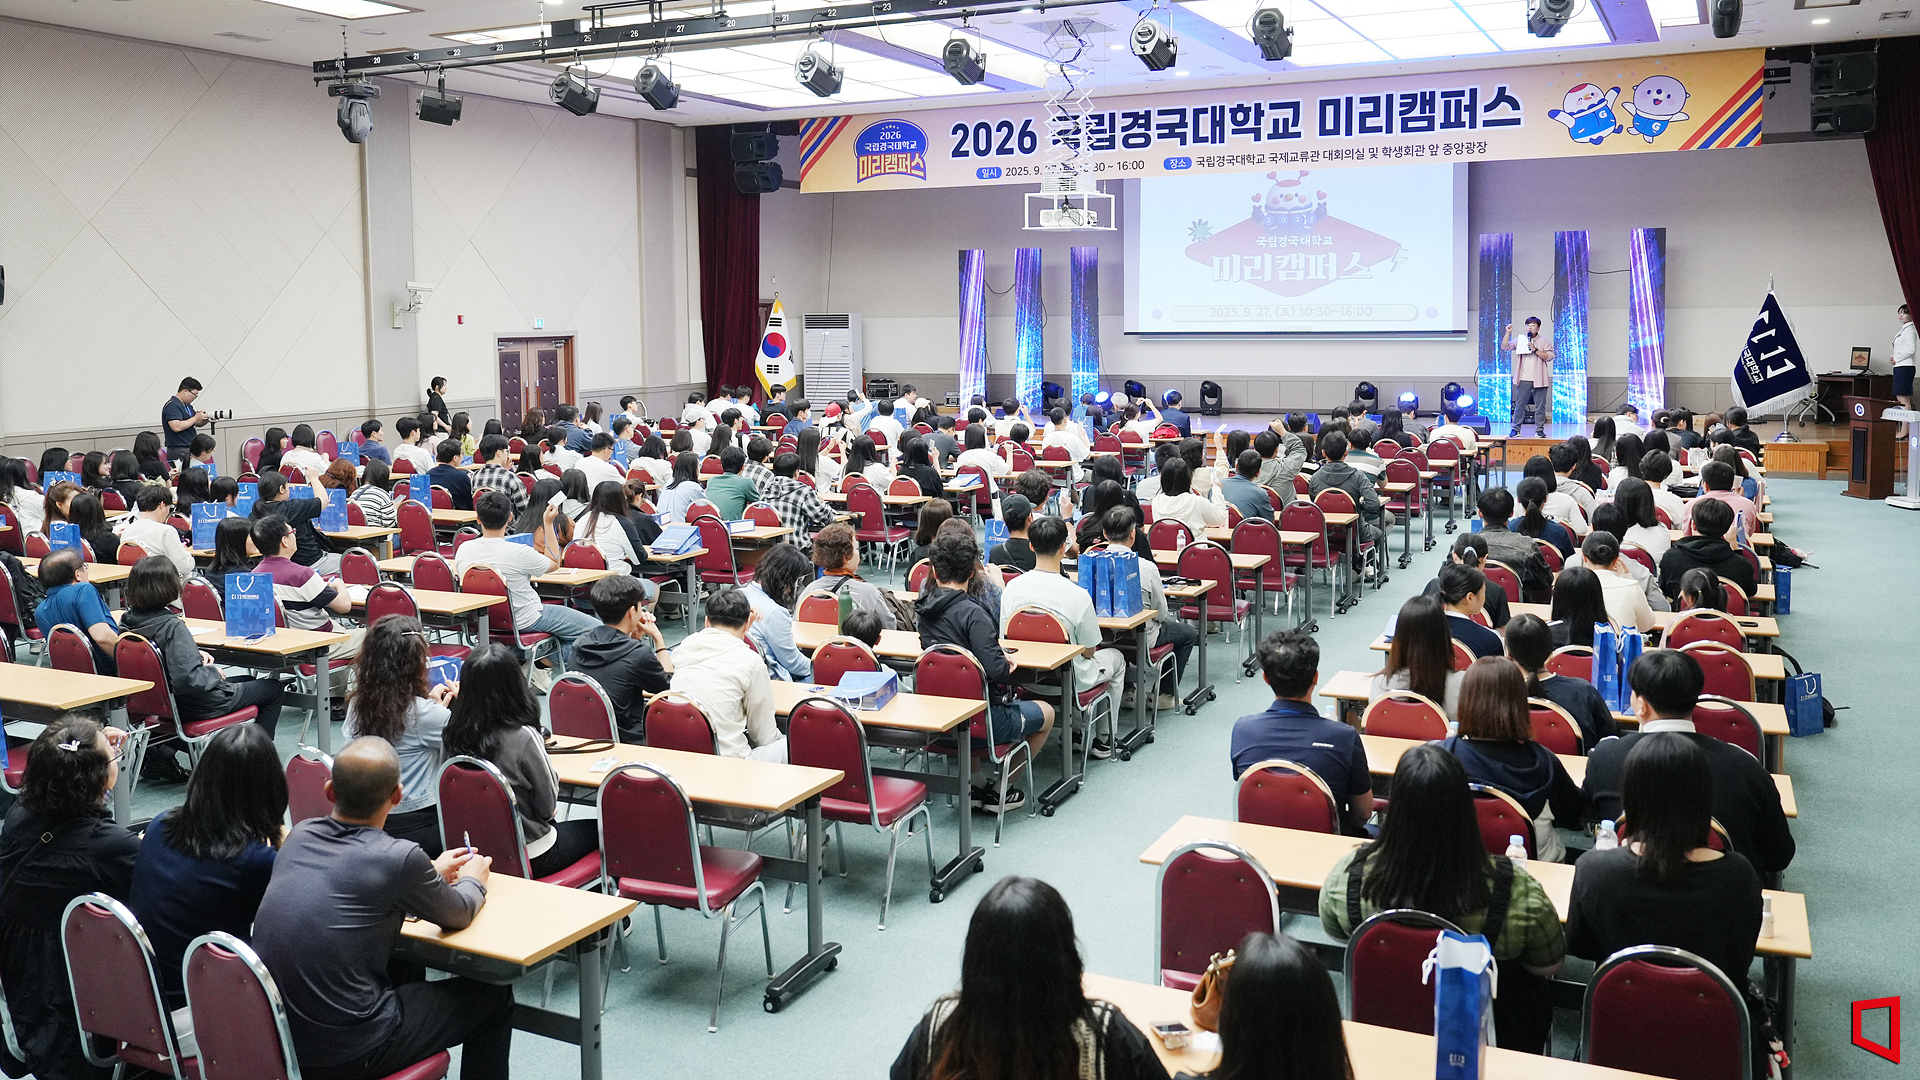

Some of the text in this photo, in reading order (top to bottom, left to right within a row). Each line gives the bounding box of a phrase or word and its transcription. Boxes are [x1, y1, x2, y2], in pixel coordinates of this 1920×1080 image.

[882, 3, 892, 11] 23
[827, 9, 837, 17] 22
[781, 14, 789, 22] 21
[726, 20, 736, 28] 20
[676, 25, 685, 33] 27
[630, 30, 639, 38] 26
[1599, 111, 1608, 119] G
[951, 86, 1522, 158] 2026 국립경국대학교 미리캠퍼스
[1652, 122, 1661, 131] G
[880, 131, 901, 140] 2026
[864, 140, 918, 152] 국립경국대학교
[1169, 141, 1488, 169] 장소 국립경국대학교 국제교류관 대회의실 및 학생회관 앞 중앙광장
[859, 153, 925, 180] 미리캠퍼스
[981, 168, 997, 179] 일시
[1005, 167, 1032, 177] 2025.
[1117, 160, 1145, 171] 16:00
[1255, 234, 1334, 248] 국립경국대학교
[1211, 251, 1373, 283] 미리캠퍼스
[1210, 305, 1373, 318] 2025. 9. 27. (토) 10:30~16:00
